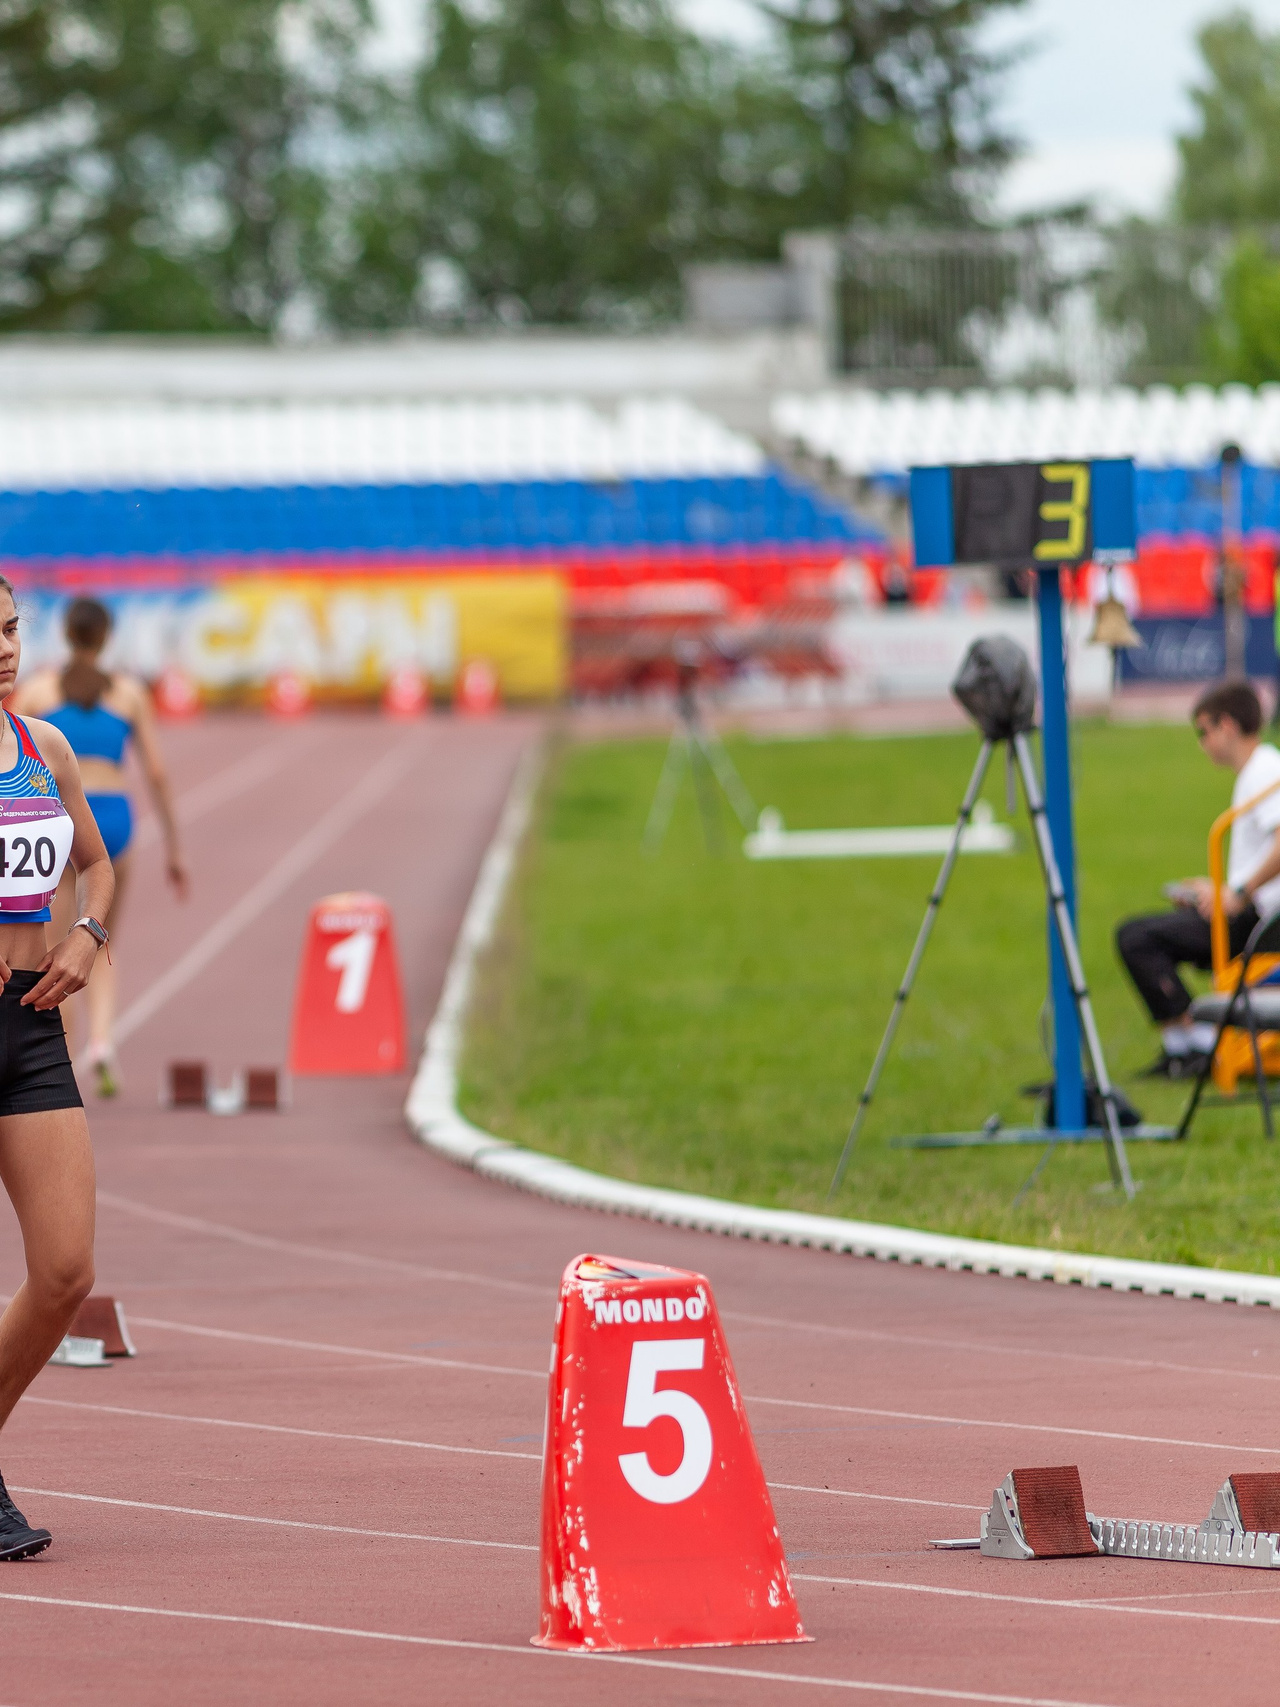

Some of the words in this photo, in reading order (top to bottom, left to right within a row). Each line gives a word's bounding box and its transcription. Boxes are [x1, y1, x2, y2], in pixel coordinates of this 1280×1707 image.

[1034, 463, 1090, 561] 3
[326, 932, 379, 1014] 1
[594, 1296, 704, 1325] MONDO
[618, 1338, 713, 1505] 5
